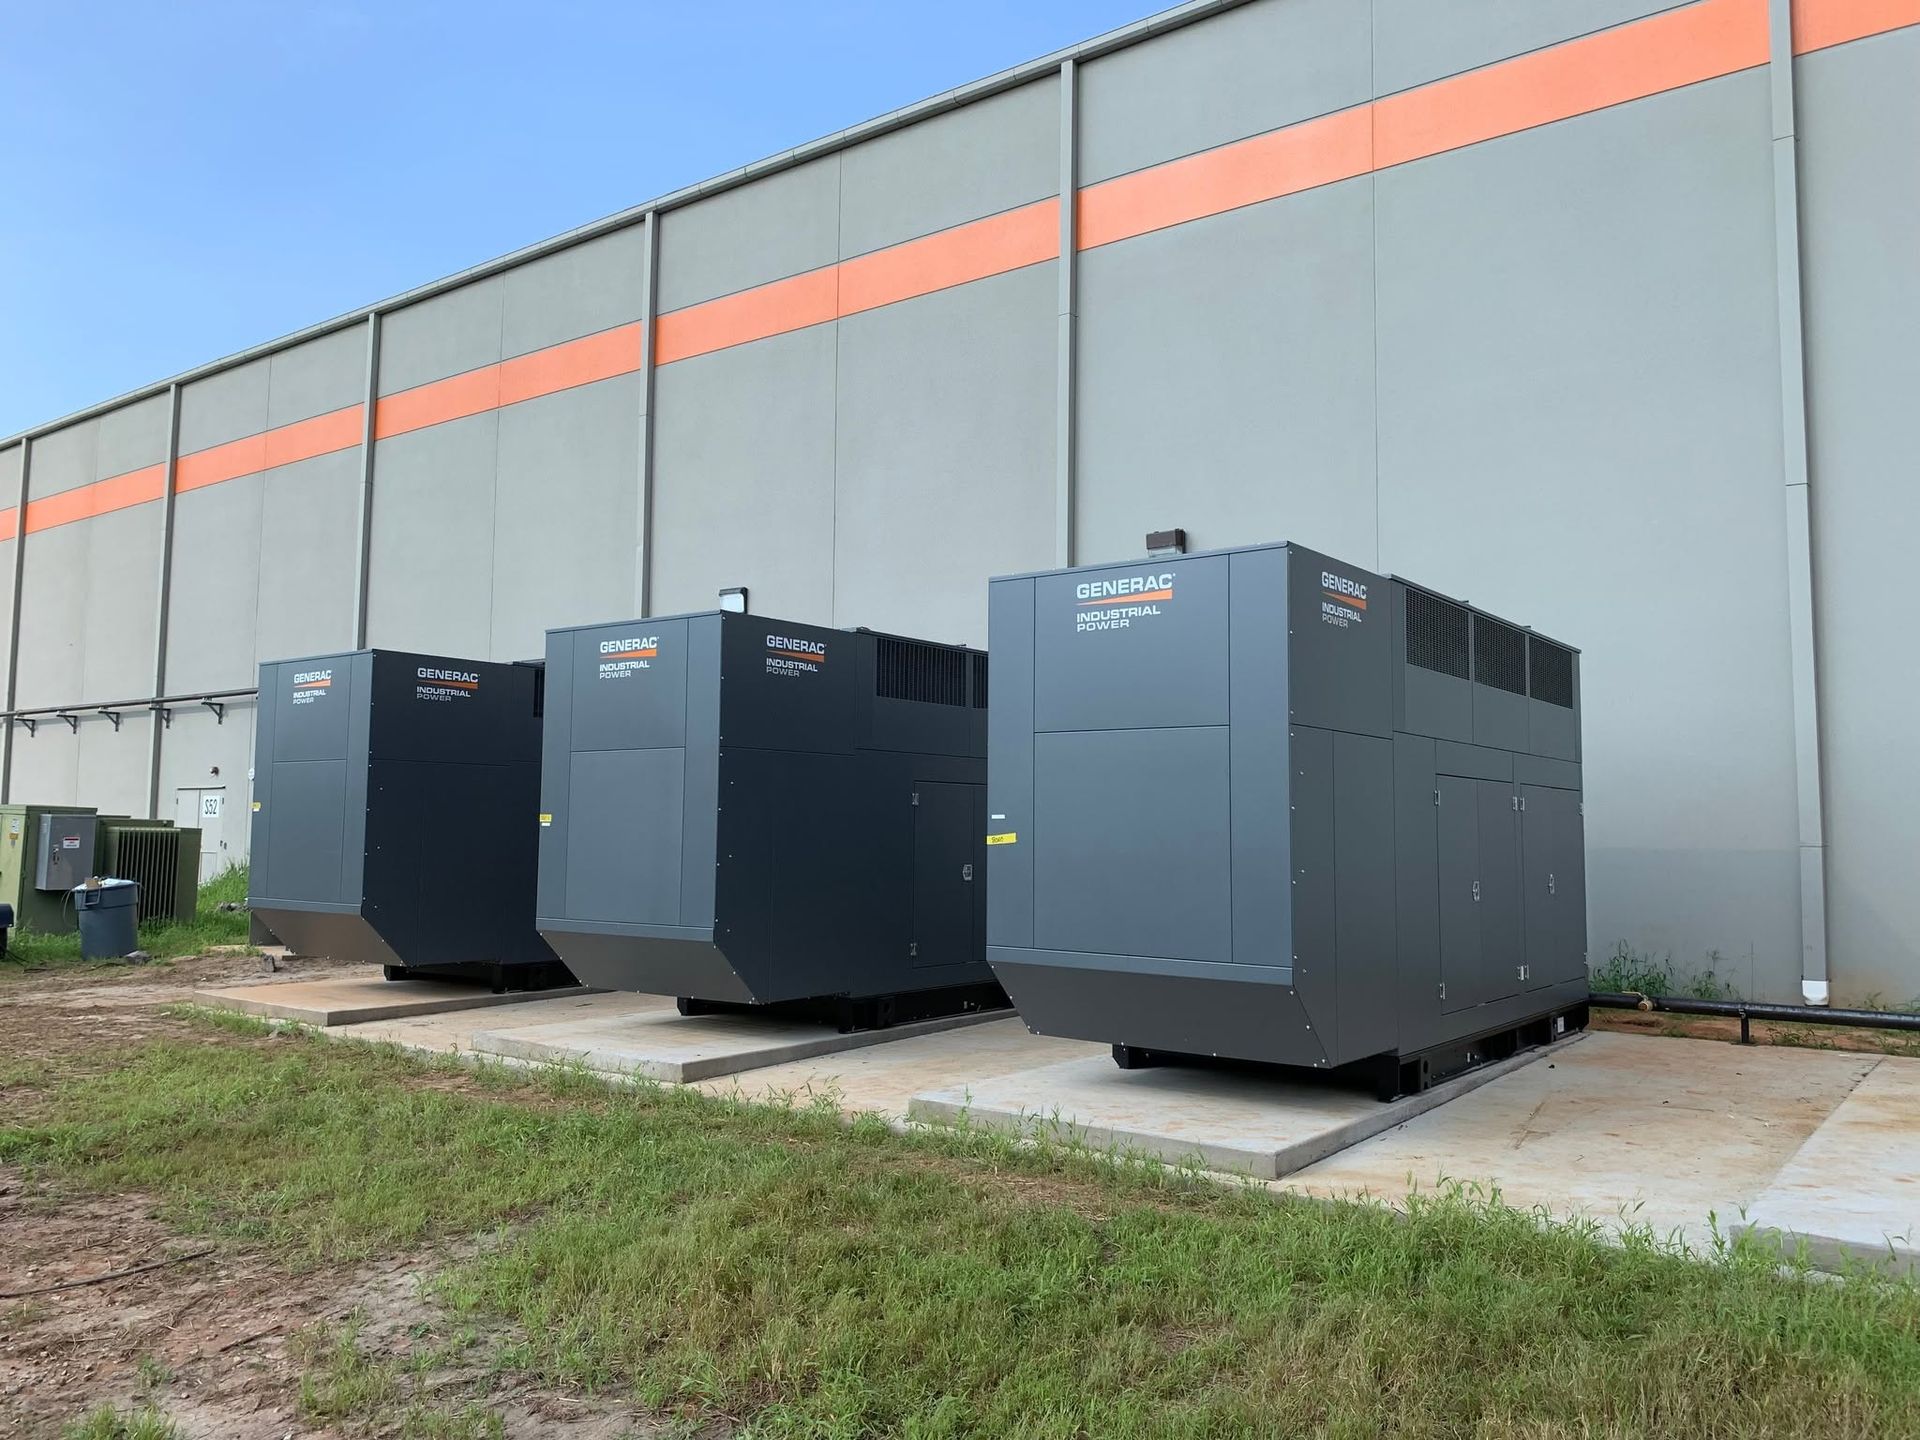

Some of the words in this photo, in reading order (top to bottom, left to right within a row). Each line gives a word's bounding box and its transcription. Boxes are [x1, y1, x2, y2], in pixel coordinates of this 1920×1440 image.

[1076, 574, 1173, 599] GENERAC
[1321, 571, 1367, 599] GENERAC
[1077, 605, 1161, 622] INDUSTRIAL
[1321, 601, 1362, 622] INDUSTRIAL
[1077, 619, 1130, 632] POWER
[1322, 613, 1349, 628] POWER
[600, 636, 657, 653] GENERAC
[766, 635, 825, 654] GENERAC
[600, 660, 650, 671] INDUSTRIAL
[766, 657, 818, 672] INDUSTRIAL
[766, 666, 800, 677] POWER
[293, 670, 332, 683] GENERAC
[417, 667, 479, 683] GENERAC
[599, 670, 632, 679] POWER
[416, 686, 471, 698] INDUSTRIAL
[416, 693, 452, 701] POWER
[204, 798, 218, 814] S52
